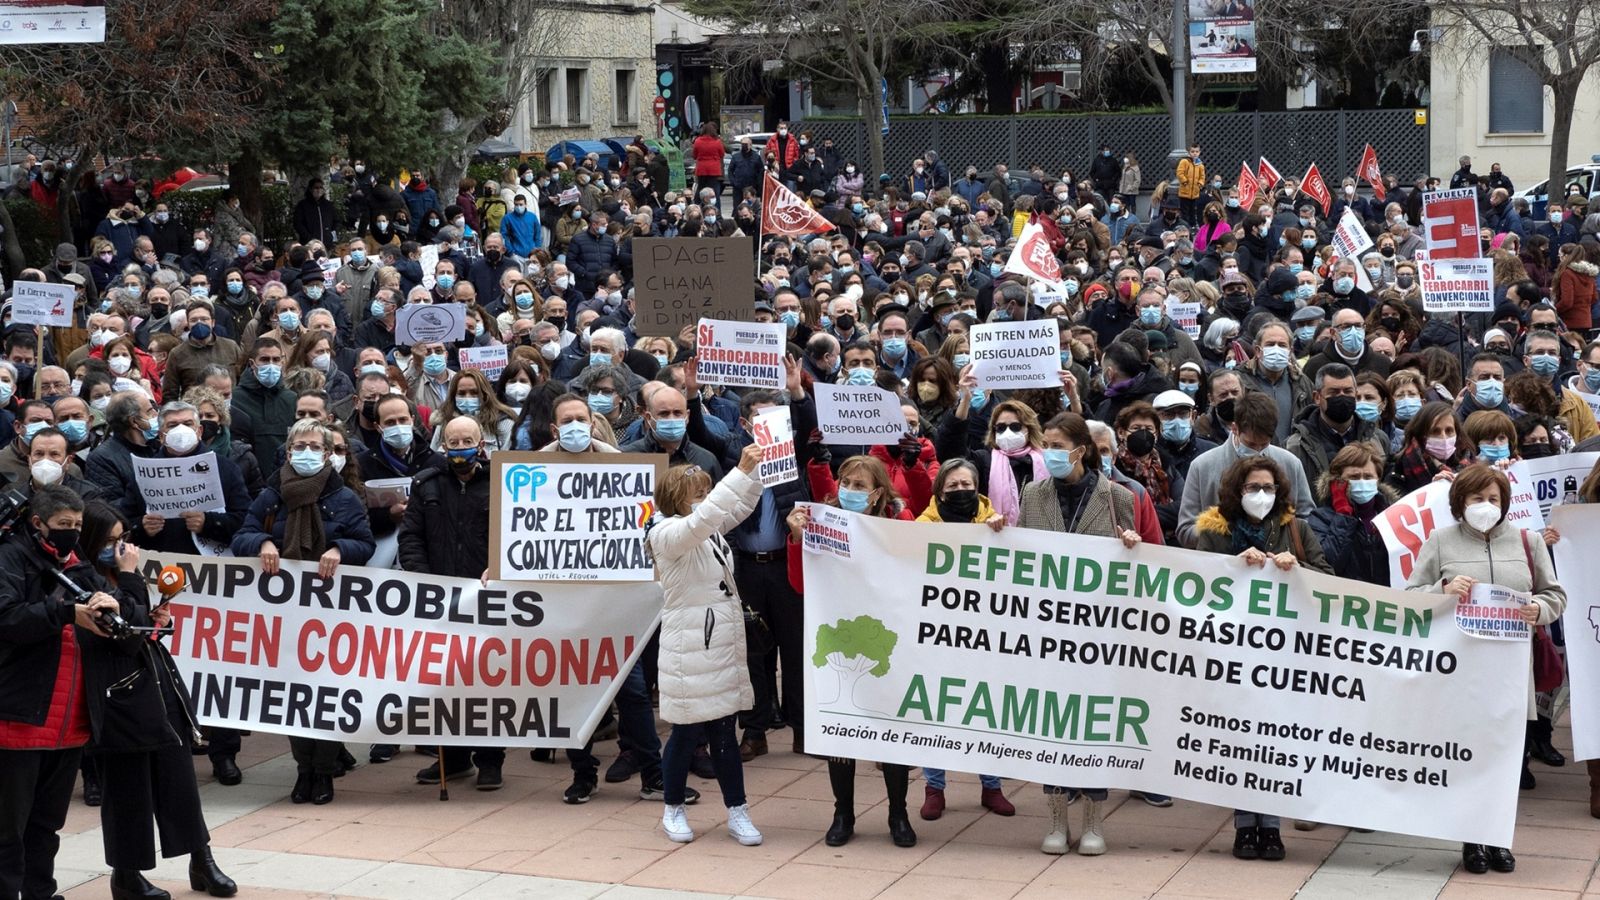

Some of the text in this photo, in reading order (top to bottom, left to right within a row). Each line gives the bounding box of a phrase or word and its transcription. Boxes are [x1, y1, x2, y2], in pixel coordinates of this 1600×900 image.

[1425, 189, 1474, 200] REVUELTA
[652, 244, 725, 268] PAGE
[646, 275, 714, 291] CHANA
[1424, 280, 1489, 292] FERROCARRIL
[1425, 291, 1490, 302] CONVENCIONAL
[736, 331, 759, 339] PUEBLOS
[975, 325, 1054, 342] SIN TREN MÁS
[697, 347, 780, 366] FERROCARRIL
[974, 345, 1055, 360] DESIGUALDAD
[697, 362, 779, 379] CONVENCIONAL
[1005, 363, 1032, 371] MENOS
[697, 374, 779, 387] MADRID CUENCA VALENCIA
[986, 373, 1046, 382] OPORTUNIDADES
[832, 392, 882, 402] SIN TREN
[838, 408, 881, 419] MAYOR
[823, 421, 902, 434] DESPOBLACIÓN
[138, 465, 182, 478] HUETE
[167, 488, 178, 497] EL
[179, 483, 206, 495] TREN
[557, 472, 653, 499] COMARCAL
[511, 506, 638, 532] POR EL TREN
[926, 542, 1433, 639] DEFENDEMOS EL TREN
[921, 584, 1458, 675] POR UN SERVICIO BÁSICO NECESARIO
[1456, 616, 1529, 632] CONVENCIONAL
[170, 602, 282, 668] TREN
[918, 621, 1366, 702] PARA LA PROVINCIA DE CUENCA
[190, 671, 571, 738] INTERES GENERAL
[897, 673, 1151, 746] AFAMMER
[1180, 706, 1473, 762] Somos motor de desarrollo
[881, 729, 899, 743] de
[902, 732, 962, 751] Familias
[965, 741, 974, 755] y
[978, 742, 1033, 761] Mujeres
[1036, 749, 1058, 765] del
[1061, 753, 1103, 768] Medio
[1107, 756, 1144, 771] Rural
[1176, 733, 1448, 788] de Familias y Mujeres del
[1173, 759, 1303, 797] Medio Rural
